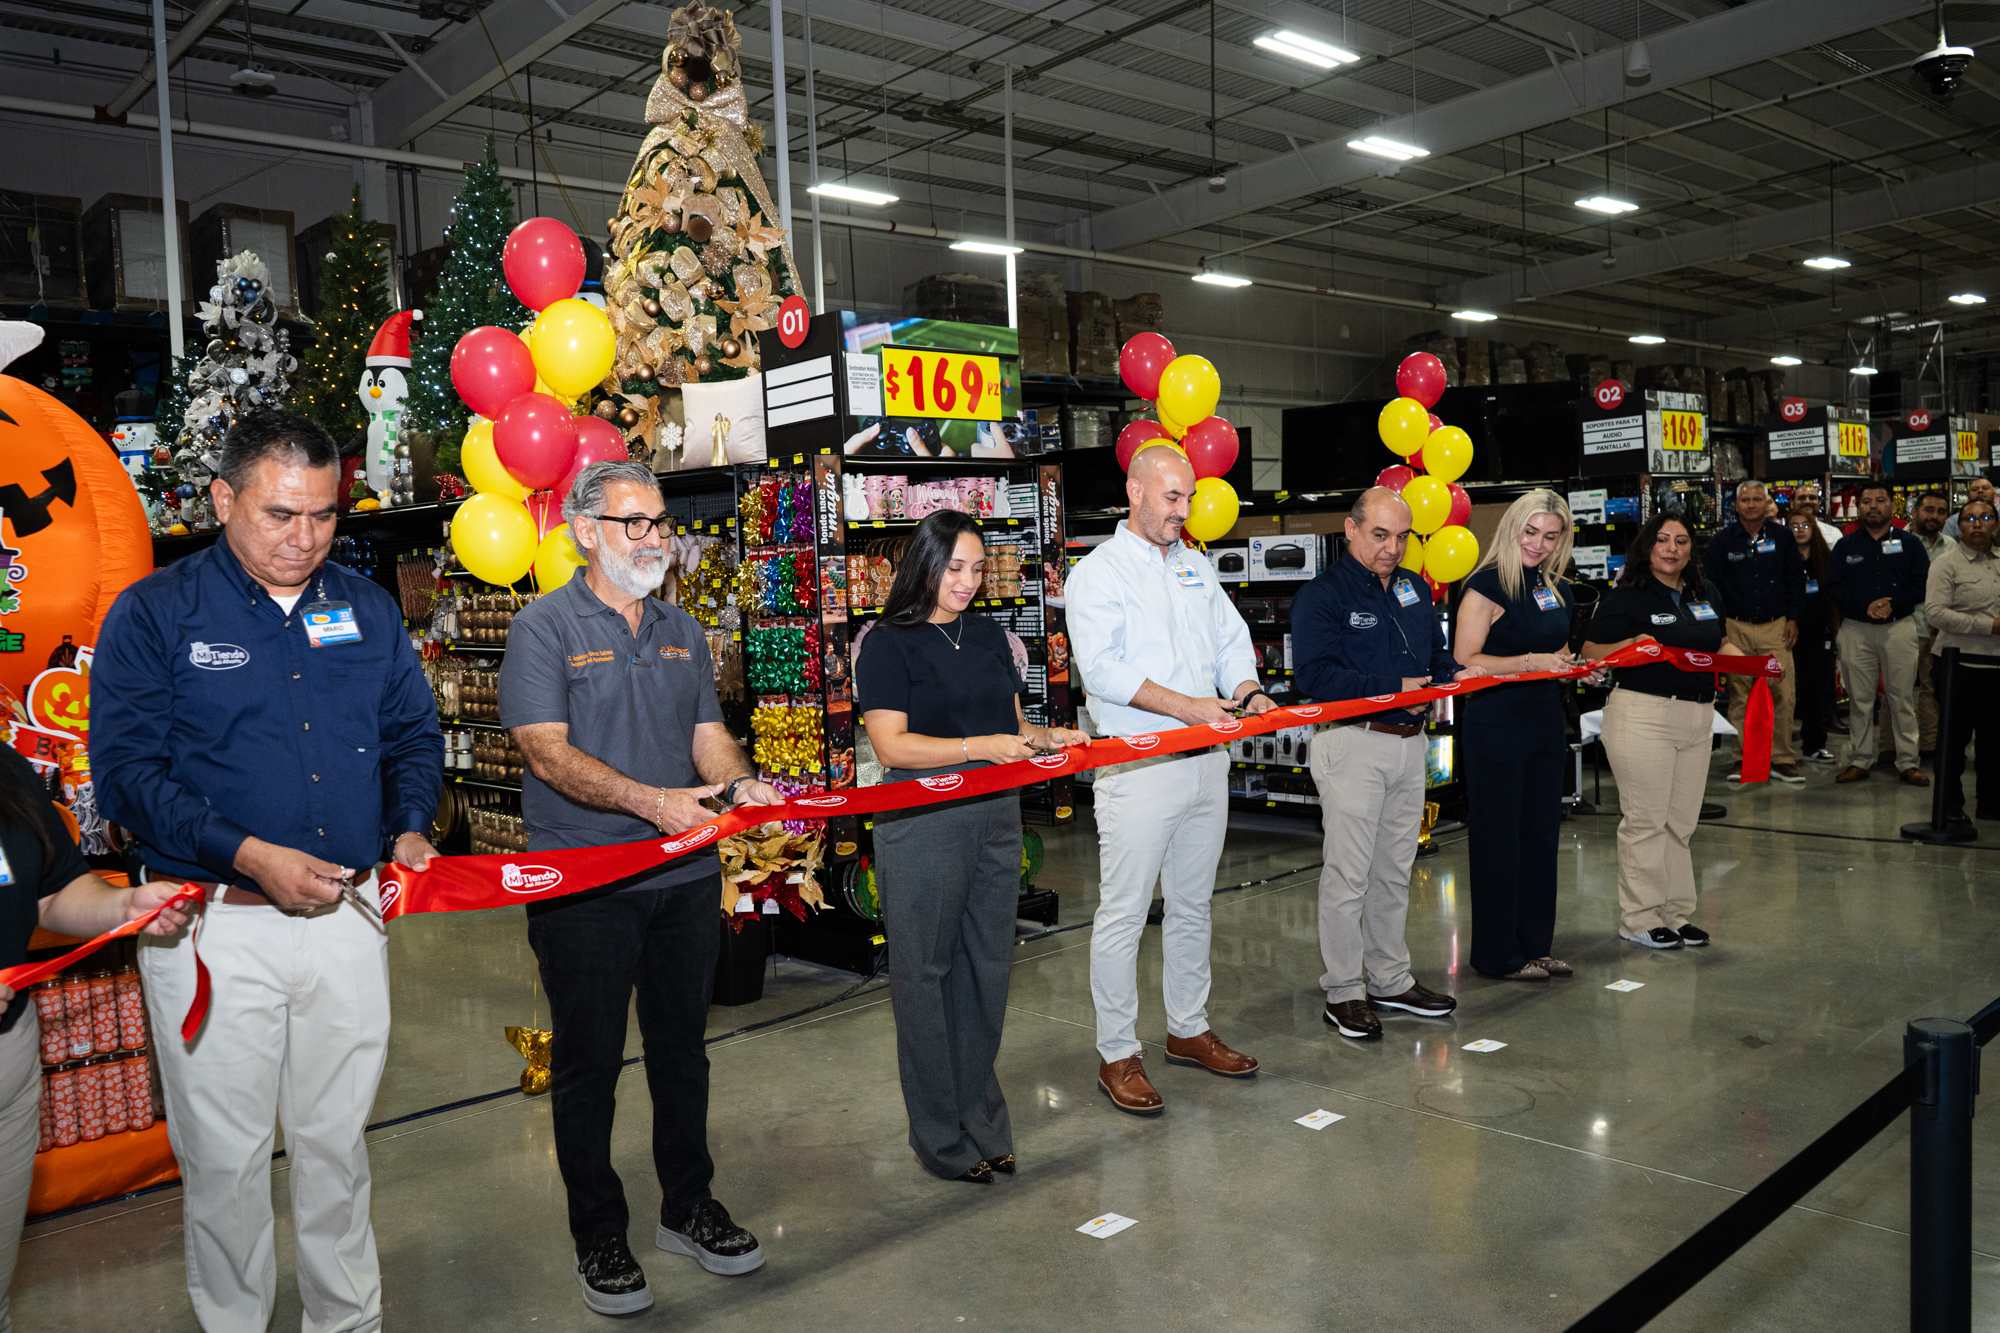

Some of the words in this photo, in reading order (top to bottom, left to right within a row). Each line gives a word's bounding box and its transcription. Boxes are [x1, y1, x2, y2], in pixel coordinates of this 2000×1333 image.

[782, 308, 804, 335] 01
[886, 355, 983, 413] $169
[987, 381, 1000, 397] PZ
[1598, 386, 1621, 403] 02
[1784, 403, 1804, 416] 03
[1585, 421, 1615, 430] SOPORTES
[1615, 418, 1630, 426] PARA
[1910, 414, 1929, 426] 04
[1602, 431, 1622, 439] AUDIO
[1663, 413, 1697, 447] $169
[1777, 430, 1815, 438] MICROONDAS
[1596, 442, 1631, 451] PANTALLAS
[1840, 425, 1863, 453] $119
[818, 489, 827, 512] nace
[823, 472, 841, 532] magia
[1046, 481, 1060, 533] magia
[819, 513, 829, 545] Donde
[1042, 517, 1051, 545] Donde
[210, 650, 246, 660] Tienda
[934, 774, 960, 784] Tienda
[682, 827, 714, 847] Tienda
[522, 871, 558, 883] Tienda
[534, 879, 554, 887] Ahorro
